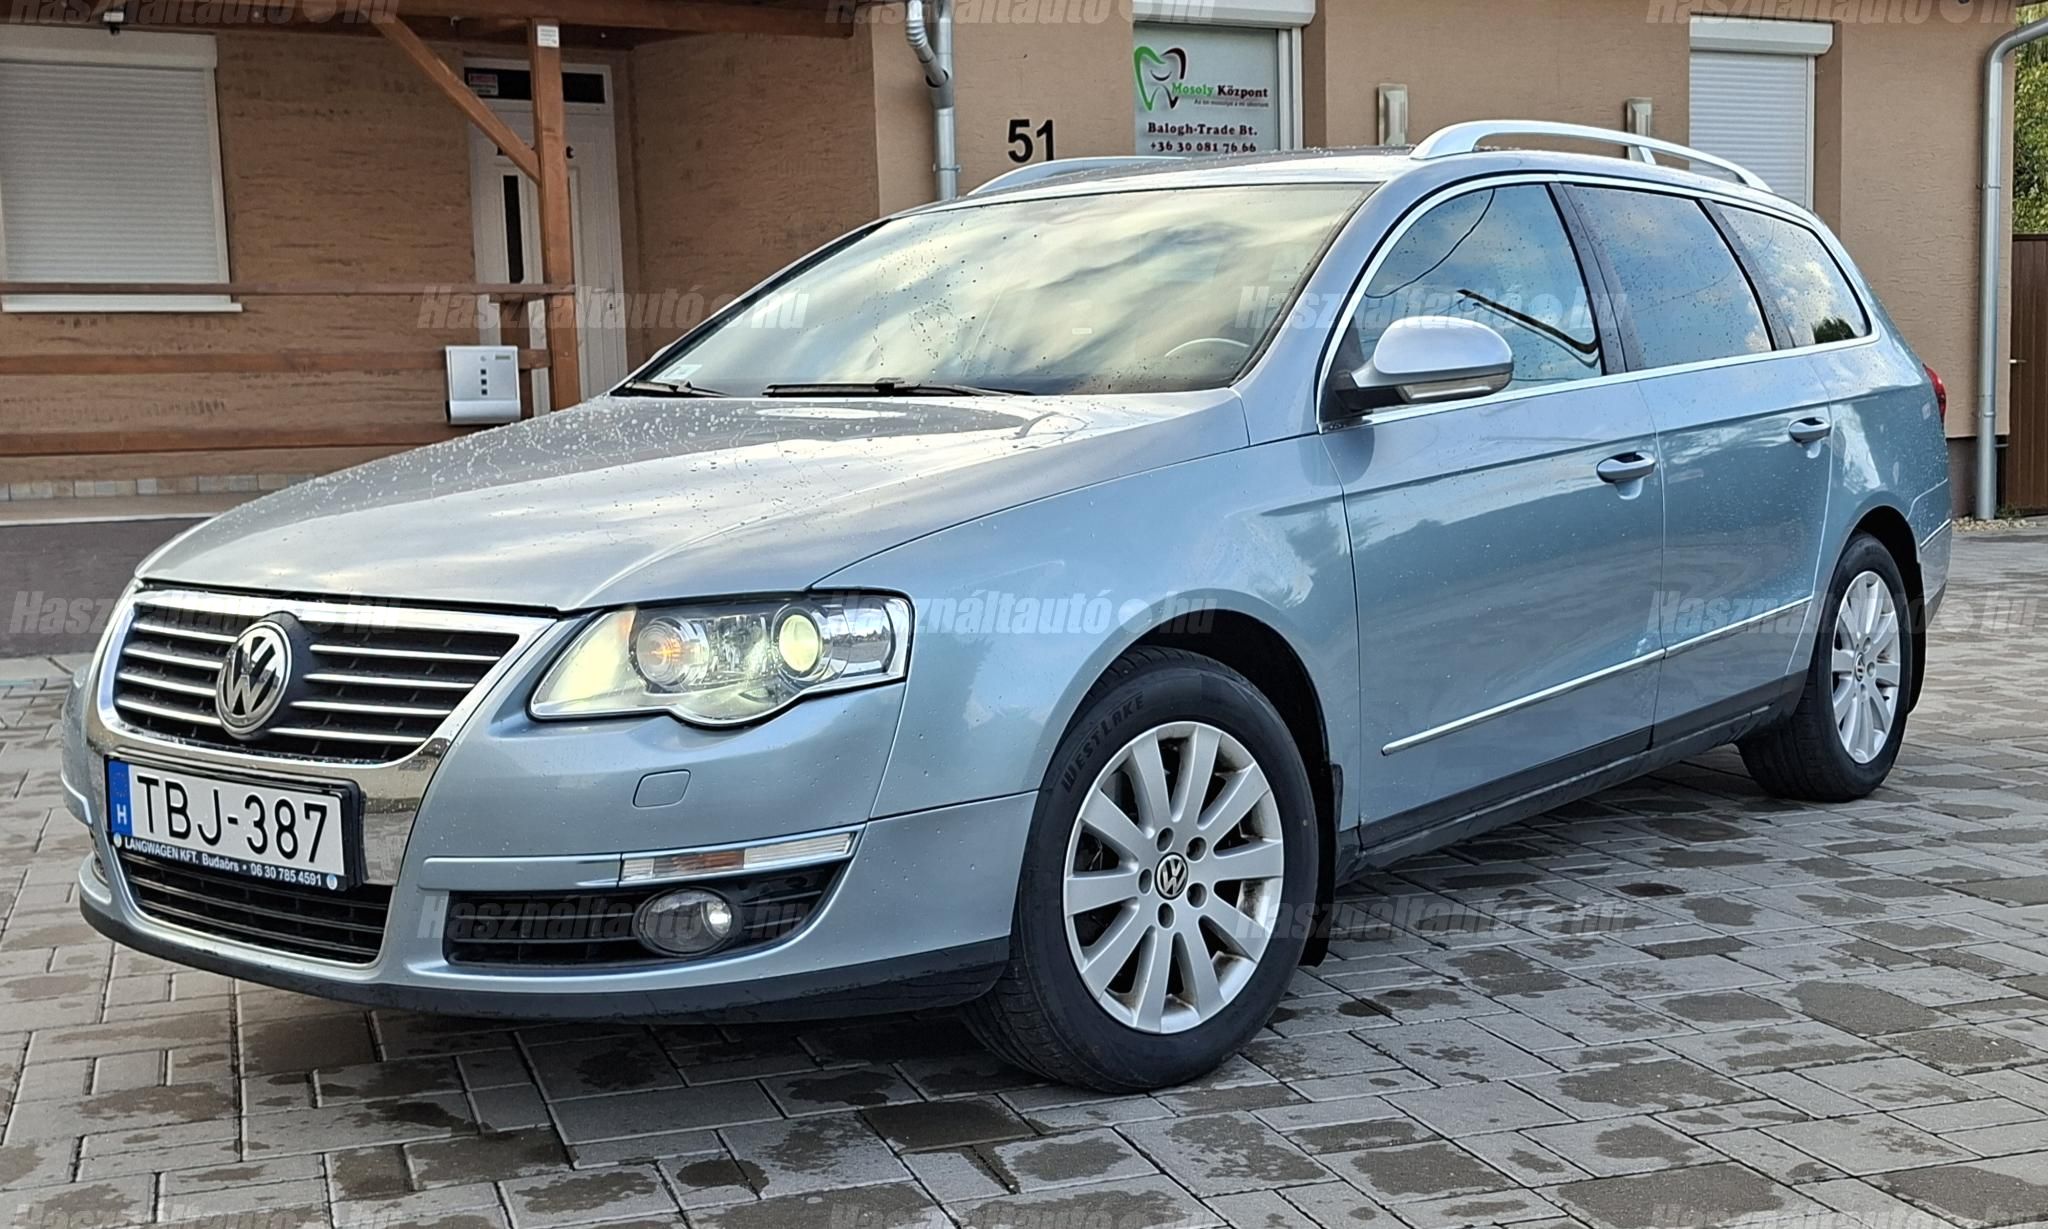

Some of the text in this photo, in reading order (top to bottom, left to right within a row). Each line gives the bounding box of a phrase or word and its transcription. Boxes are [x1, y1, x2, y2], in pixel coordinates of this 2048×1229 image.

[1171, 83, 1268, 99] Mosoly Központ
[1008, 119, 1054, 163] 51
[1148, 122, 1258, 136] Balogh-Trade Bt.
[1150, 141, 1257, 154] +36 30 081 76 66
[1061, 693, 1144, 793] WESTLAKE
[117, 804, 128, 825] H
[136, 775, 328, 863] TBJ-387
[124, 837, 179, 860] LANGWAGEN
[180, 848, 199, 864] KFT.
[250, 863, 263, 877] 06
[264, 865, 277, 879] 30
[278, 868, 297, 882] 785
[298, 871, 322, 887] 4591
